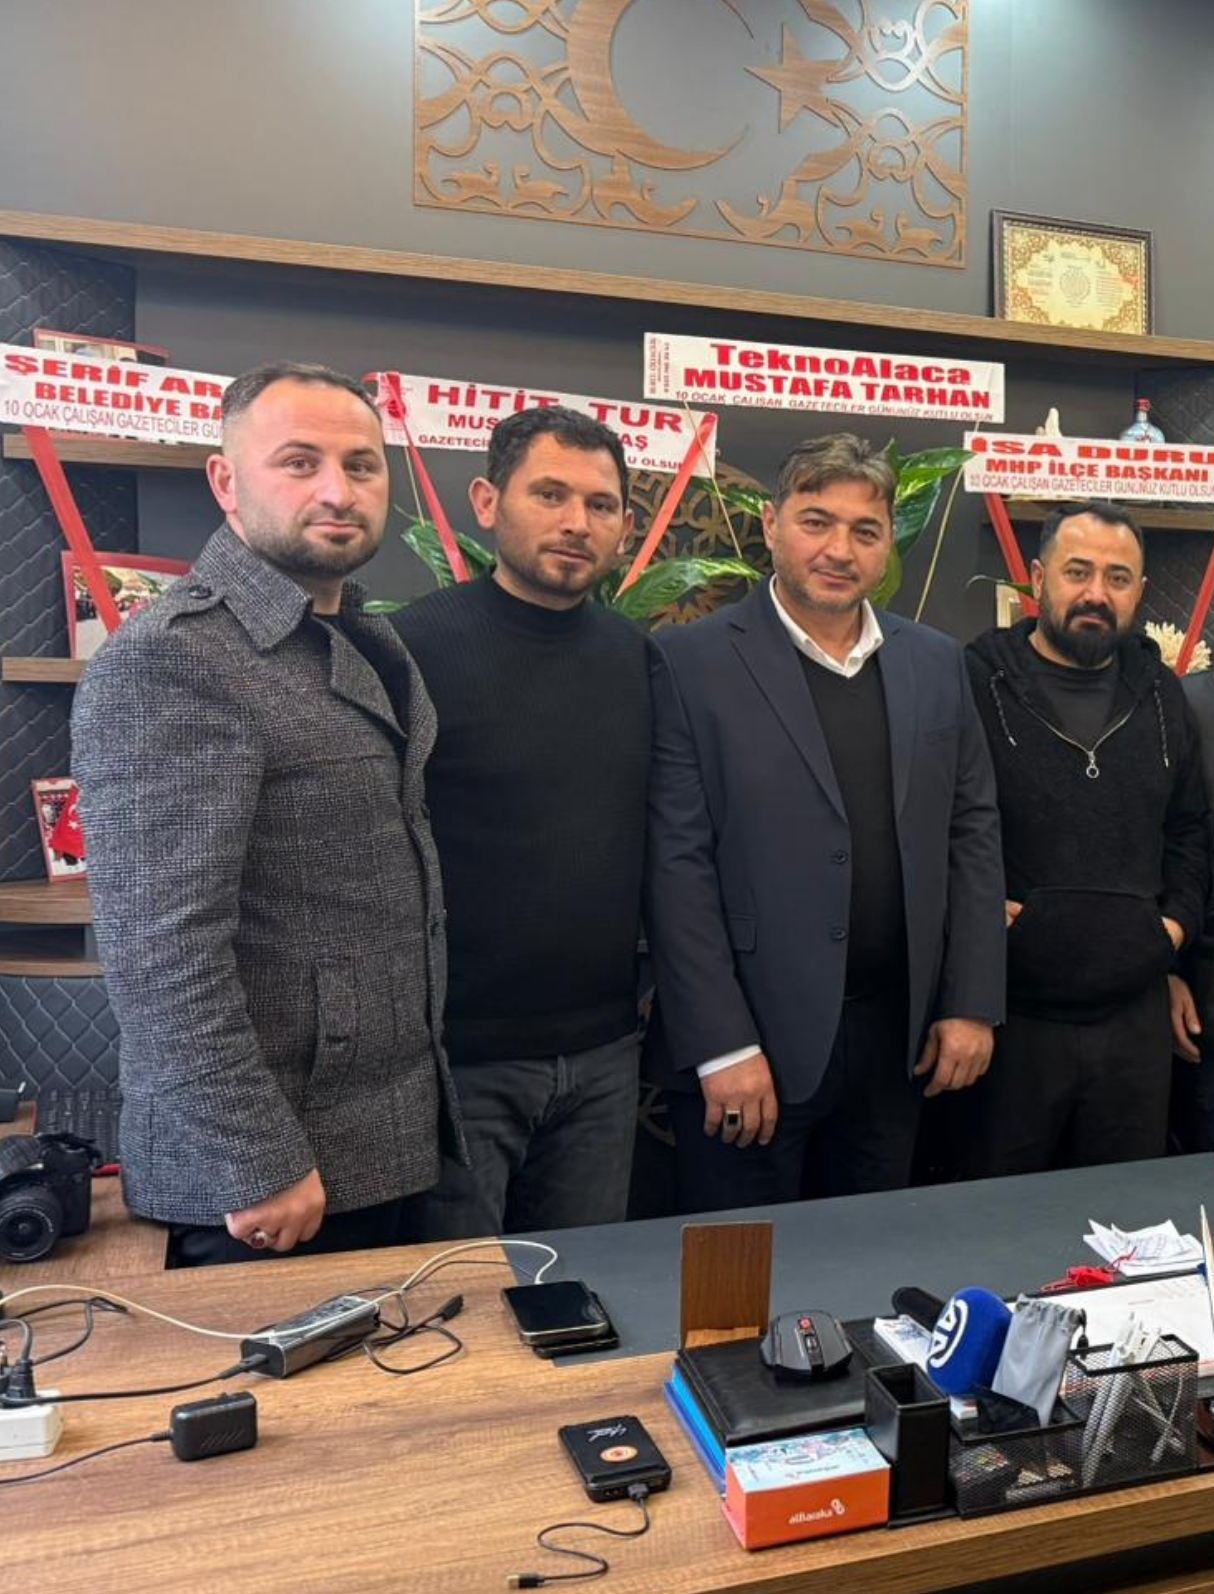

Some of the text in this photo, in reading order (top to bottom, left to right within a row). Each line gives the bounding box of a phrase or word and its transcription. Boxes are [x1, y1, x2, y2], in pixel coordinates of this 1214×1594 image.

[4, 354, 150, 387] ŞERİF
[710, 344, 970, 385] TeknoAlaca
[35, 381, 181, 416] BELEDİYE
[676, 391, 688, 399] 10
[691, 391, 725, 402] OCAK
[684, 368, 990, 409] MUSTAFA TARHAN
[4, 400, 20, 417] 10
[22, 402, 59, 419] OCAK
[62, 406, 114, 428] ÇALIŞAN
[588, 402, 682, 433] TUR
[982, 475, 1011, 487] OCAK
[986, 458, 1208, 482] MHP İLÇE BAŞKANI
